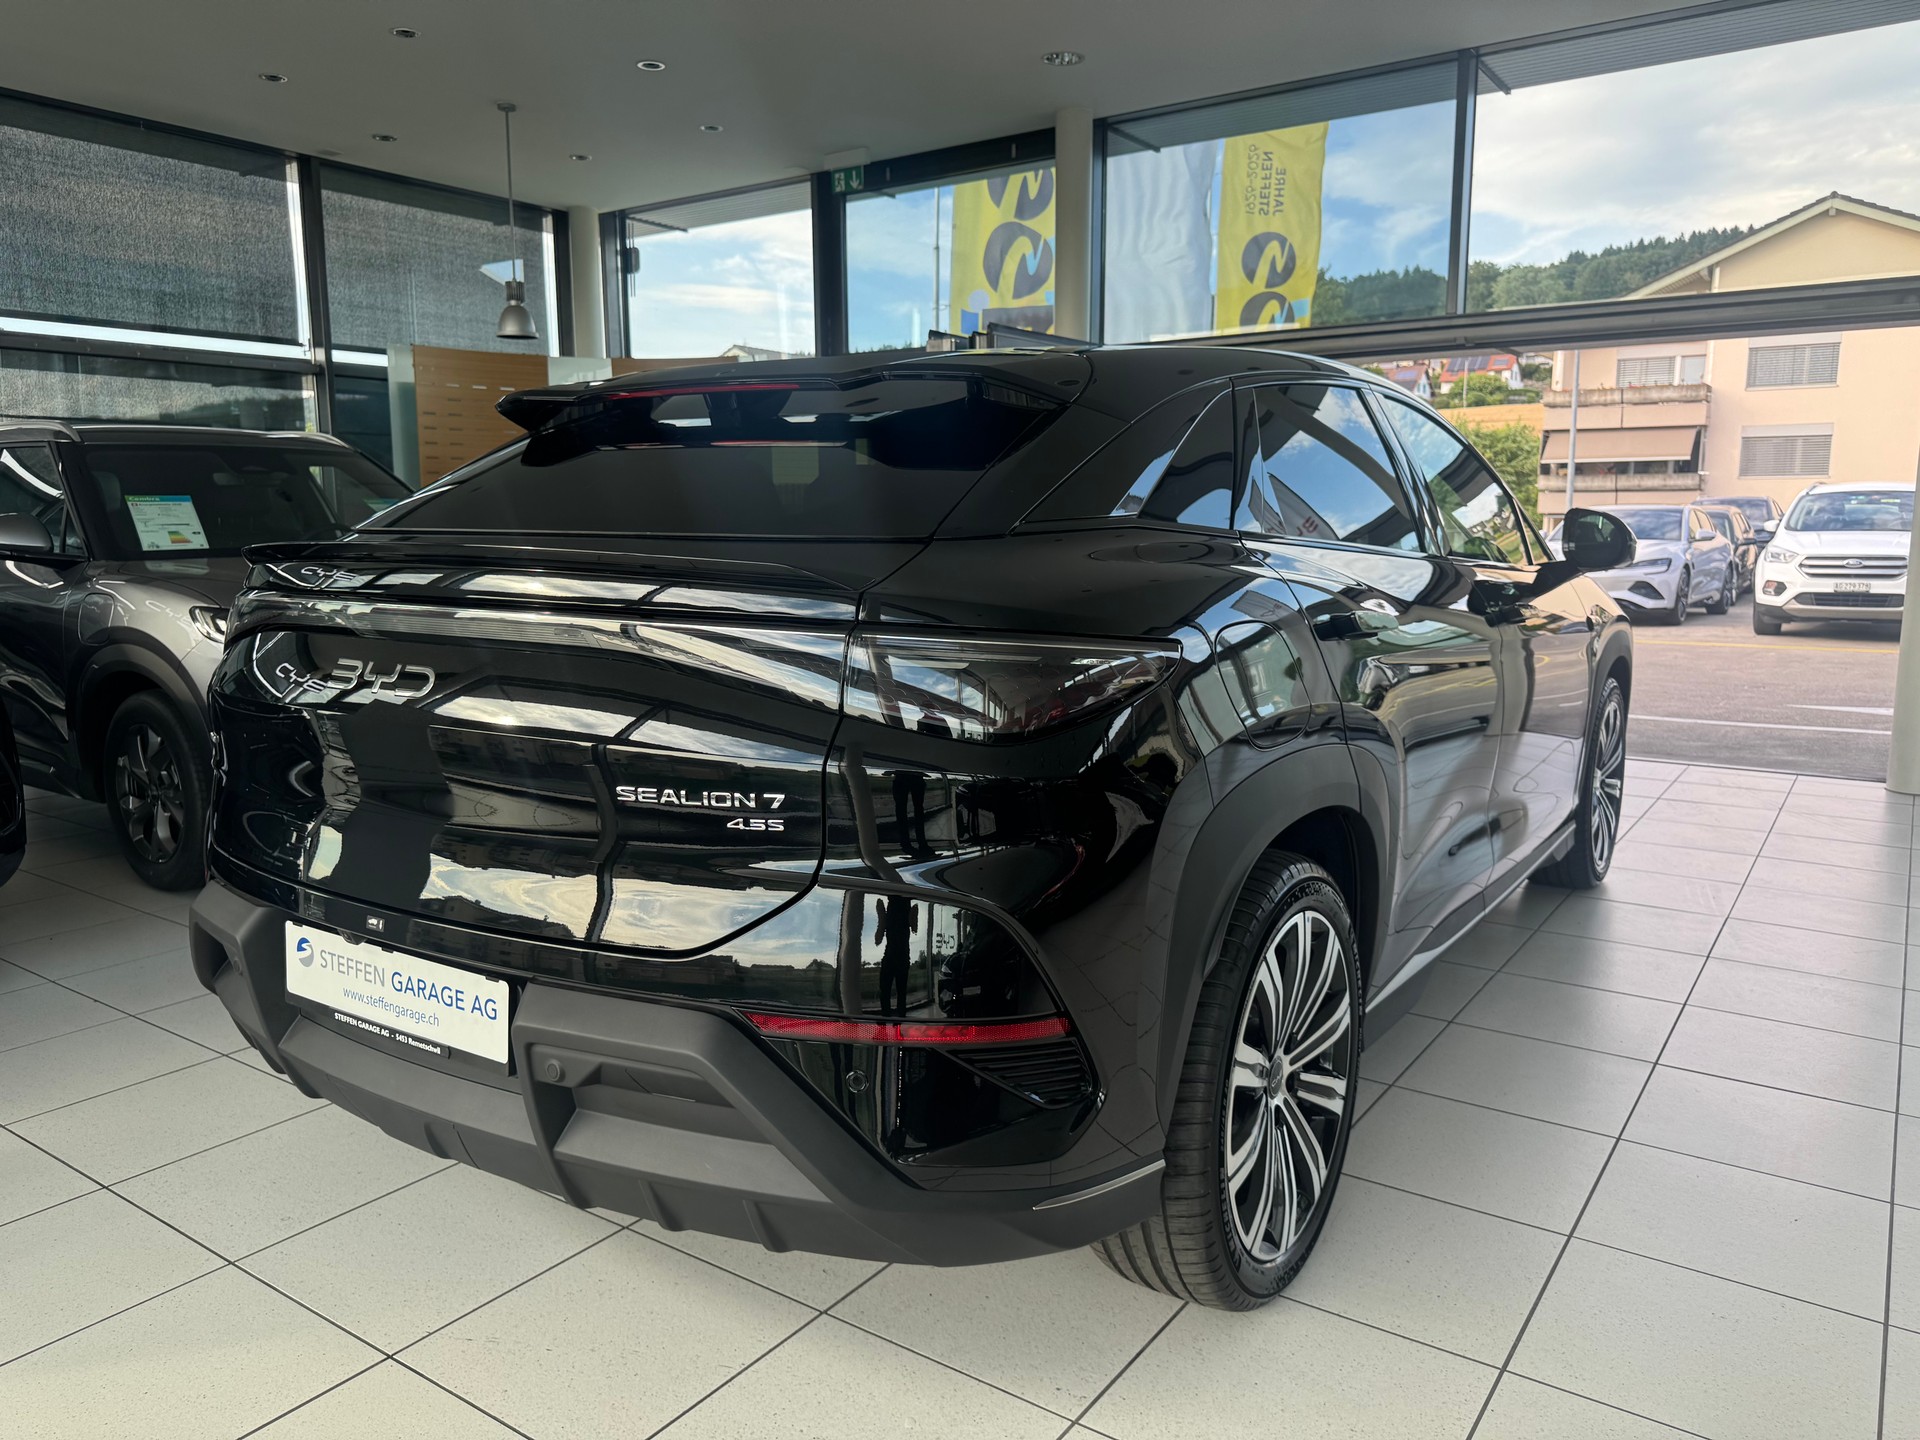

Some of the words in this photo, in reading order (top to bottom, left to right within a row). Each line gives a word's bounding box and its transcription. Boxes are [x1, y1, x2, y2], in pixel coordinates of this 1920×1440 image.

[327, 657, 435, 698] BYD
[615, 785, 756, 808] SEALION
[763, 793, 786, 809] 7
[320, 950, 386, 987] STEFFEN
[391, 971, 465, 1011] GARAGE
[471, 995, 497, 1020] AG
[334, 1012, 357, 1027] STEFFEN
[358, 1019, 381, 1035] GARAGE
[381, 1027, 390, 1037] AG
[343, 987, 440, 1027] www.steffengarage.ch
[1220, 1167, 1236, 1252] MICHELIN
